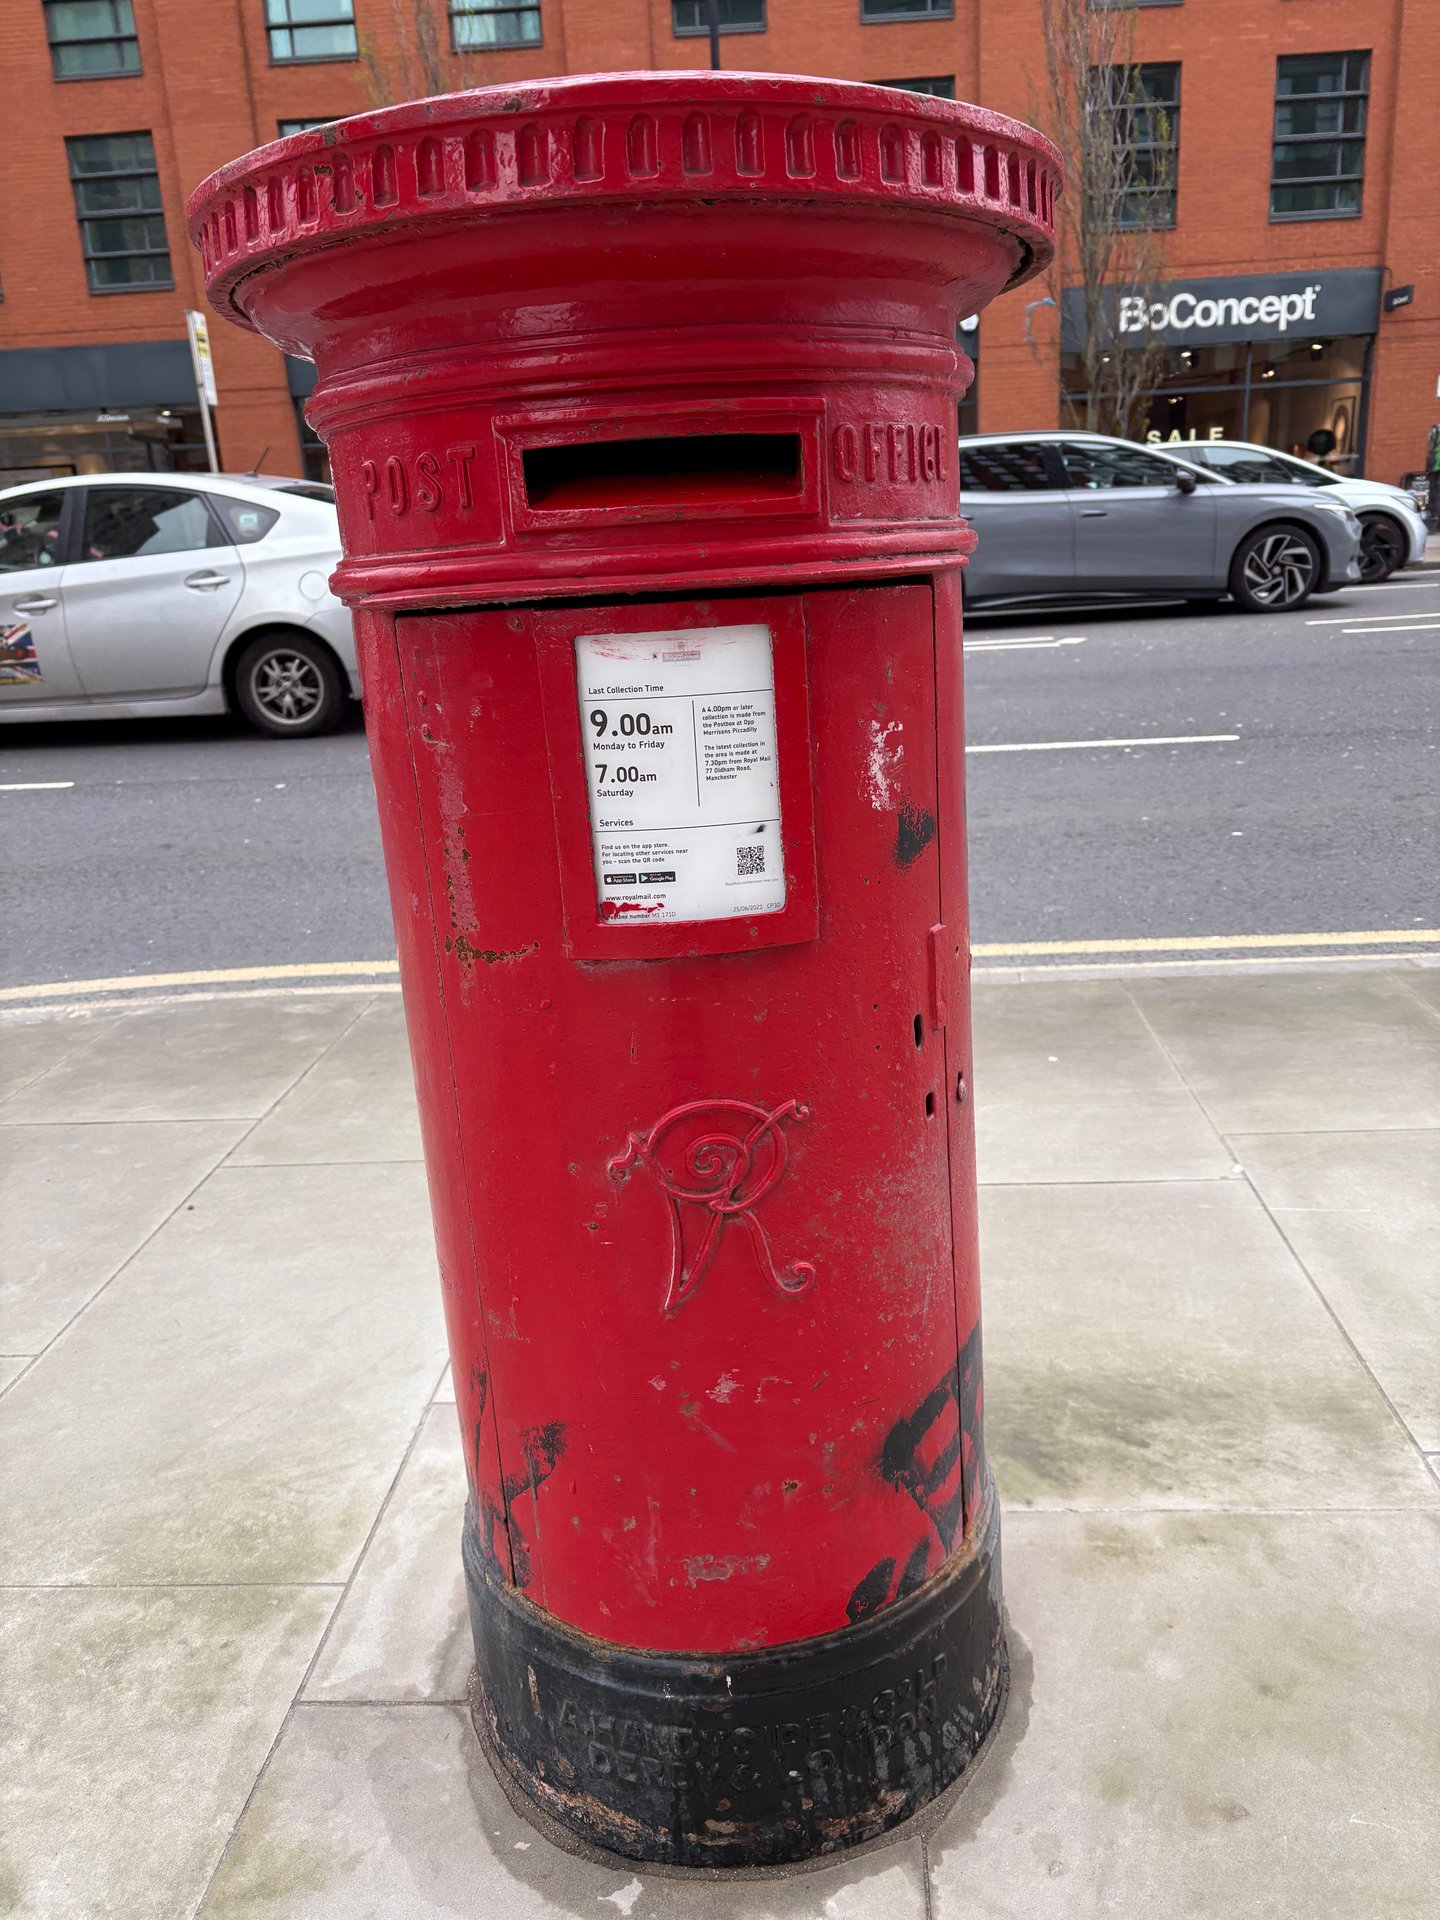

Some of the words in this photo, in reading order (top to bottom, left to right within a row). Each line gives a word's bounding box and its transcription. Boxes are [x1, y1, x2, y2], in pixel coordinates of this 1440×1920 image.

[1119, 284, 1317, 332] BoConcept
[1146, 427, 1224, 444] SALE
[833, 421, 946, 482] OFFICE
[360, 446, 477, 520] POST
[590, 710, 673, 737] 9.00am
[593, 743, 625, 751] Monday
[639, 741, 665, 749] Friday
[595, 764, 656, 783] 7.00am
[597, 789, 633, 797] Saturday
[599, 819, 633, 827] Services
[605, 894, 666, 902] www.royalmail.com
